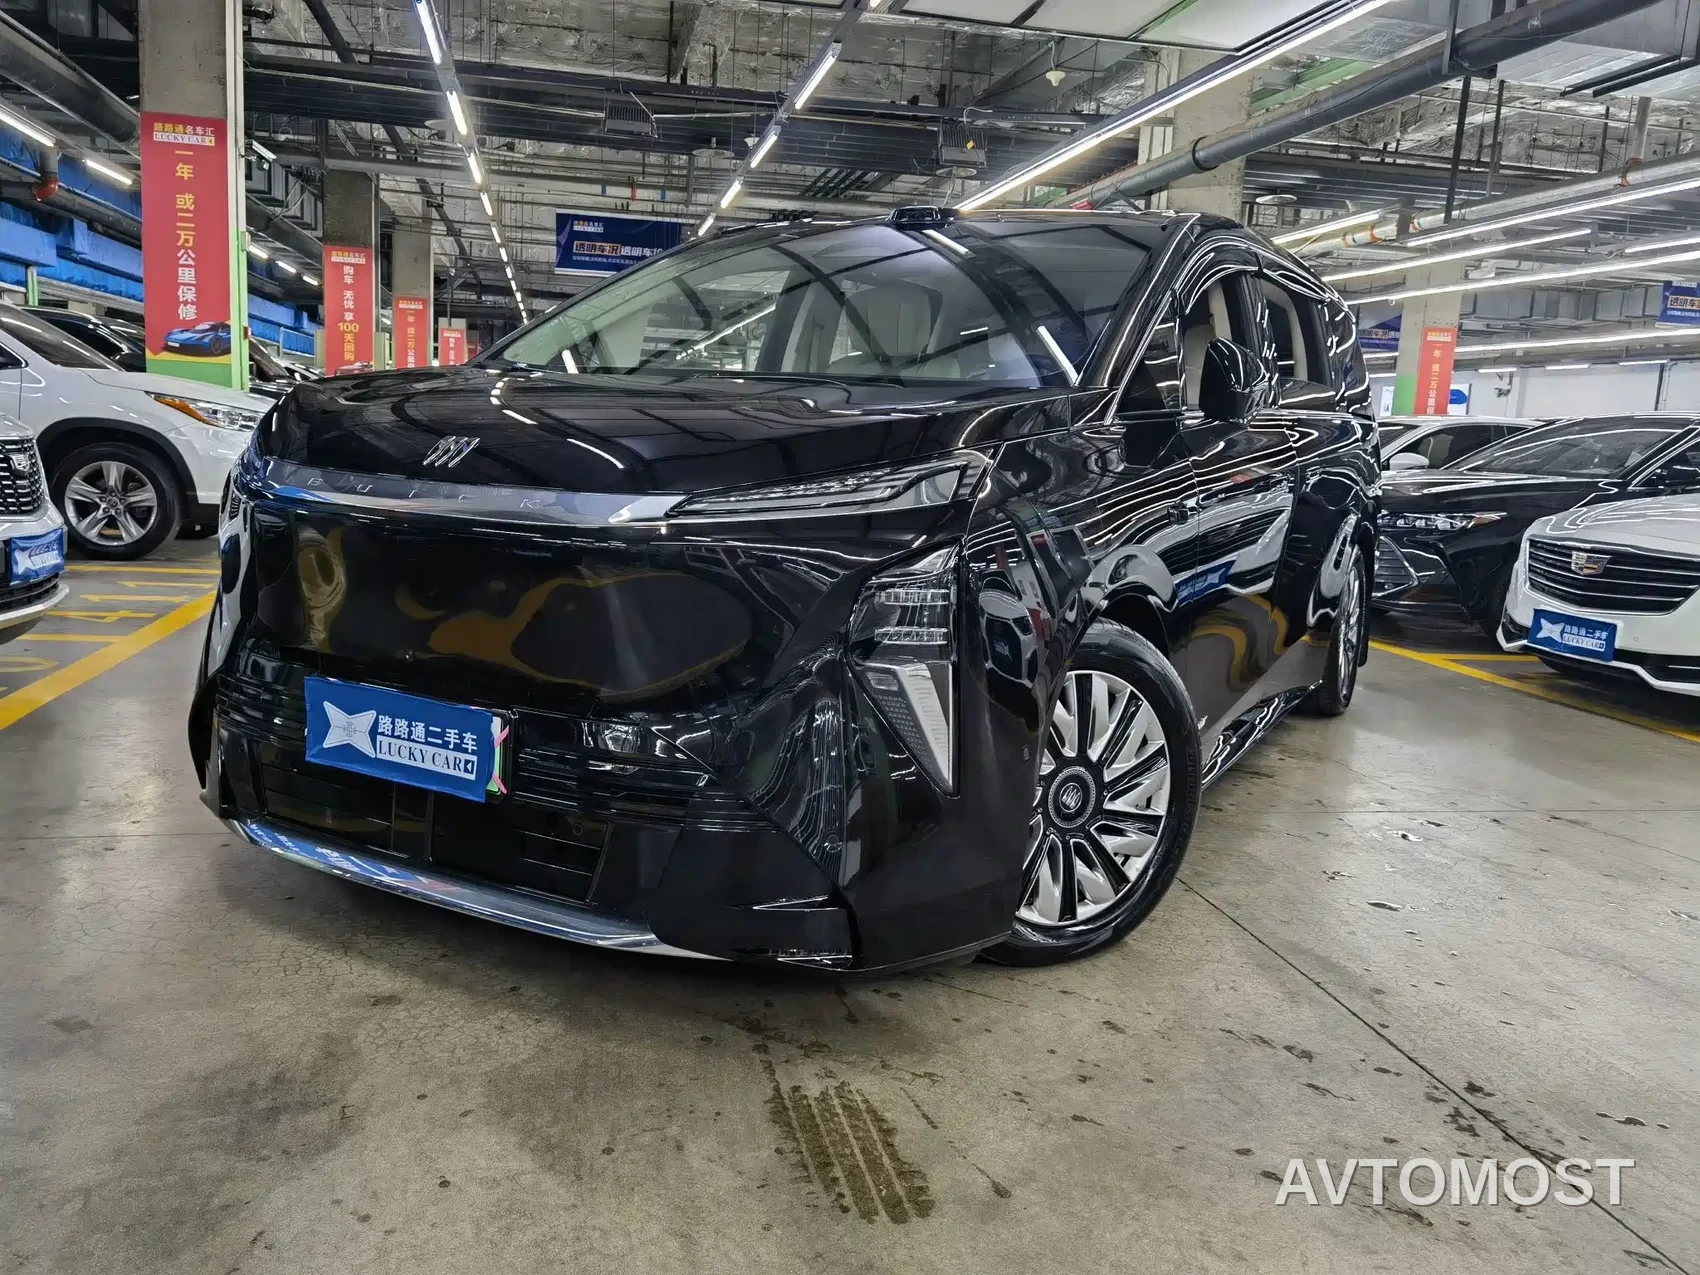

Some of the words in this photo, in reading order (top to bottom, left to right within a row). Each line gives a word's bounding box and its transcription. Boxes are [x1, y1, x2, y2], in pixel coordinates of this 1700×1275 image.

[154, 133, 187, 142] LUCKY
[188, 136, 207, 144] CAR
[377, 714, 478, 753] 路路通二手车
[378, 739, 429, 765] LUCKY
[431, 750, 462, 772] CAR
